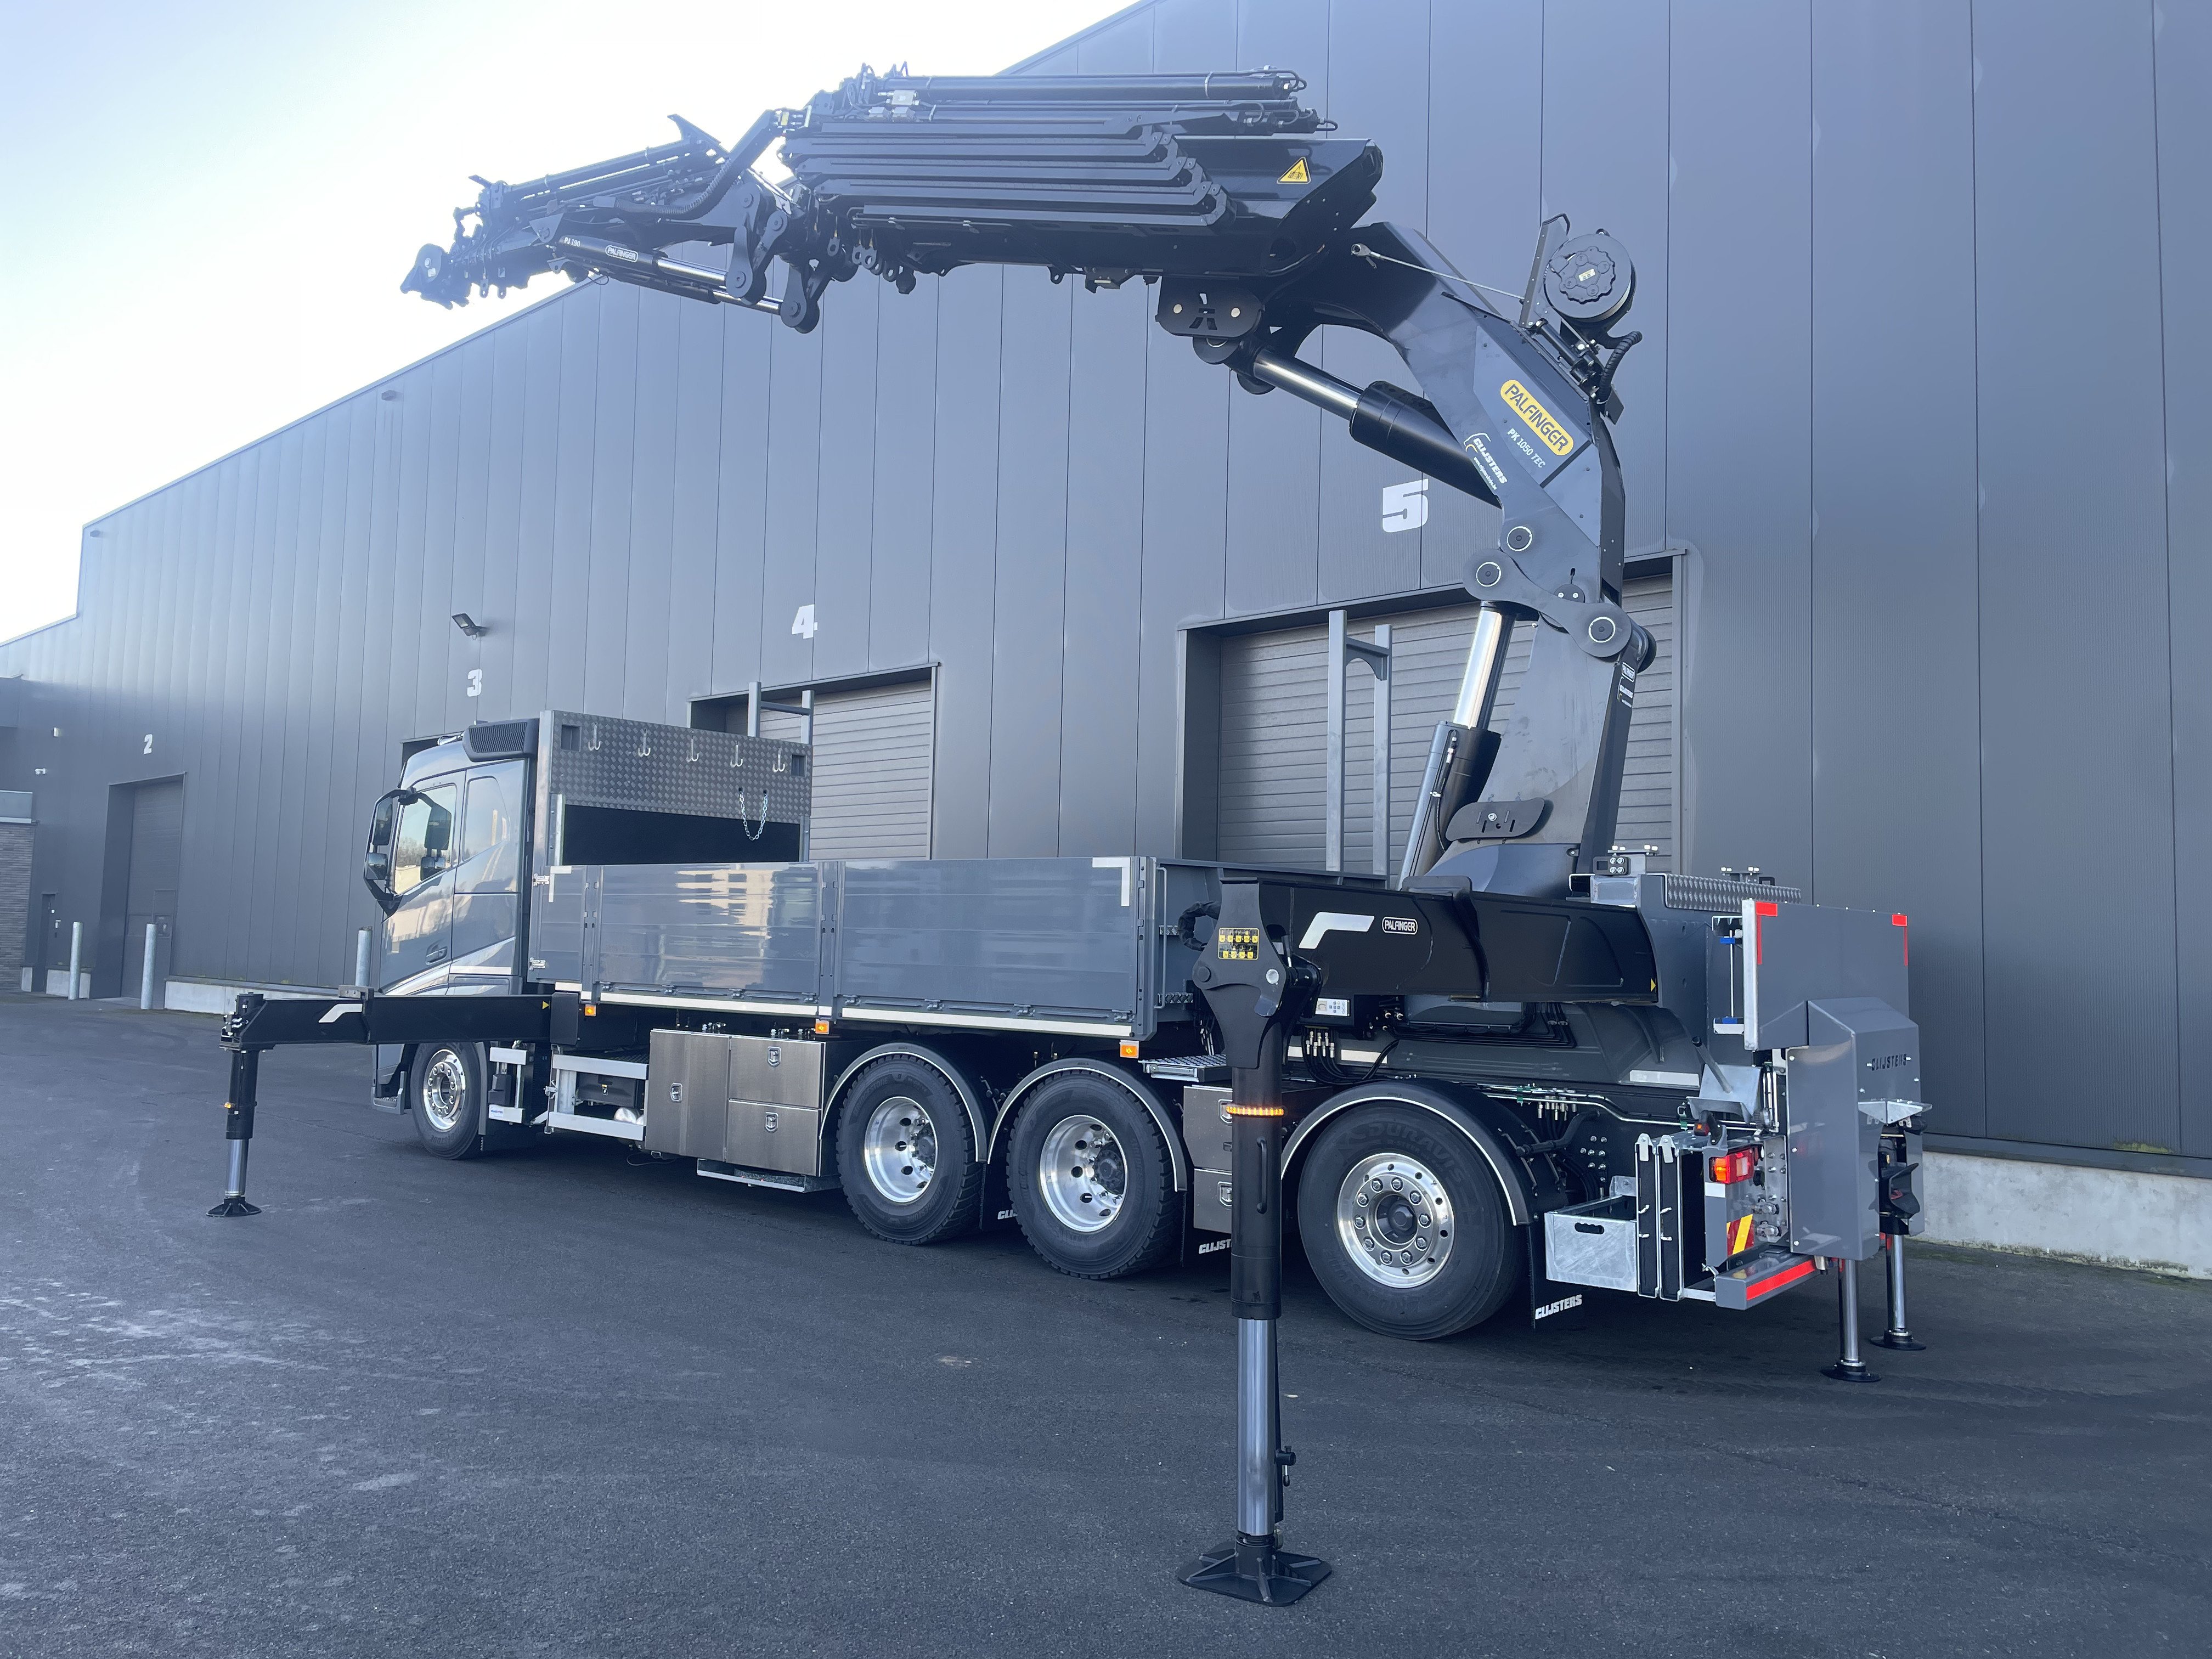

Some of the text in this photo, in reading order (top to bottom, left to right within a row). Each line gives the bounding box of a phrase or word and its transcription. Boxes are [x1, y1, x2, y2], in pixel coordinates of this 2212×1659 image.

[571, 239, 580, 247] 190
[607, 247, 636, 260] PALFINGER
[1504, 383, 1568, 452] PALFINGER
[1473, 437, 1508, 484] CLIJSTERS
[1507, 428, 1546, 469] PK 1050 TEC
[1383, 478, 1429, 533] 5
[792, 604, 818, 639] 4
[467, 669, 482, 697] 3
[143, 733, 153, 754] 2
[1385, 919, 1415, 932] PALFINGER
[1369, 1122, 1465, 1183] DURAVIS
[1198, 1238, 1232, 1254] CLIJST
[1534, 1294, 1582, 1320] CLIJSTERS
